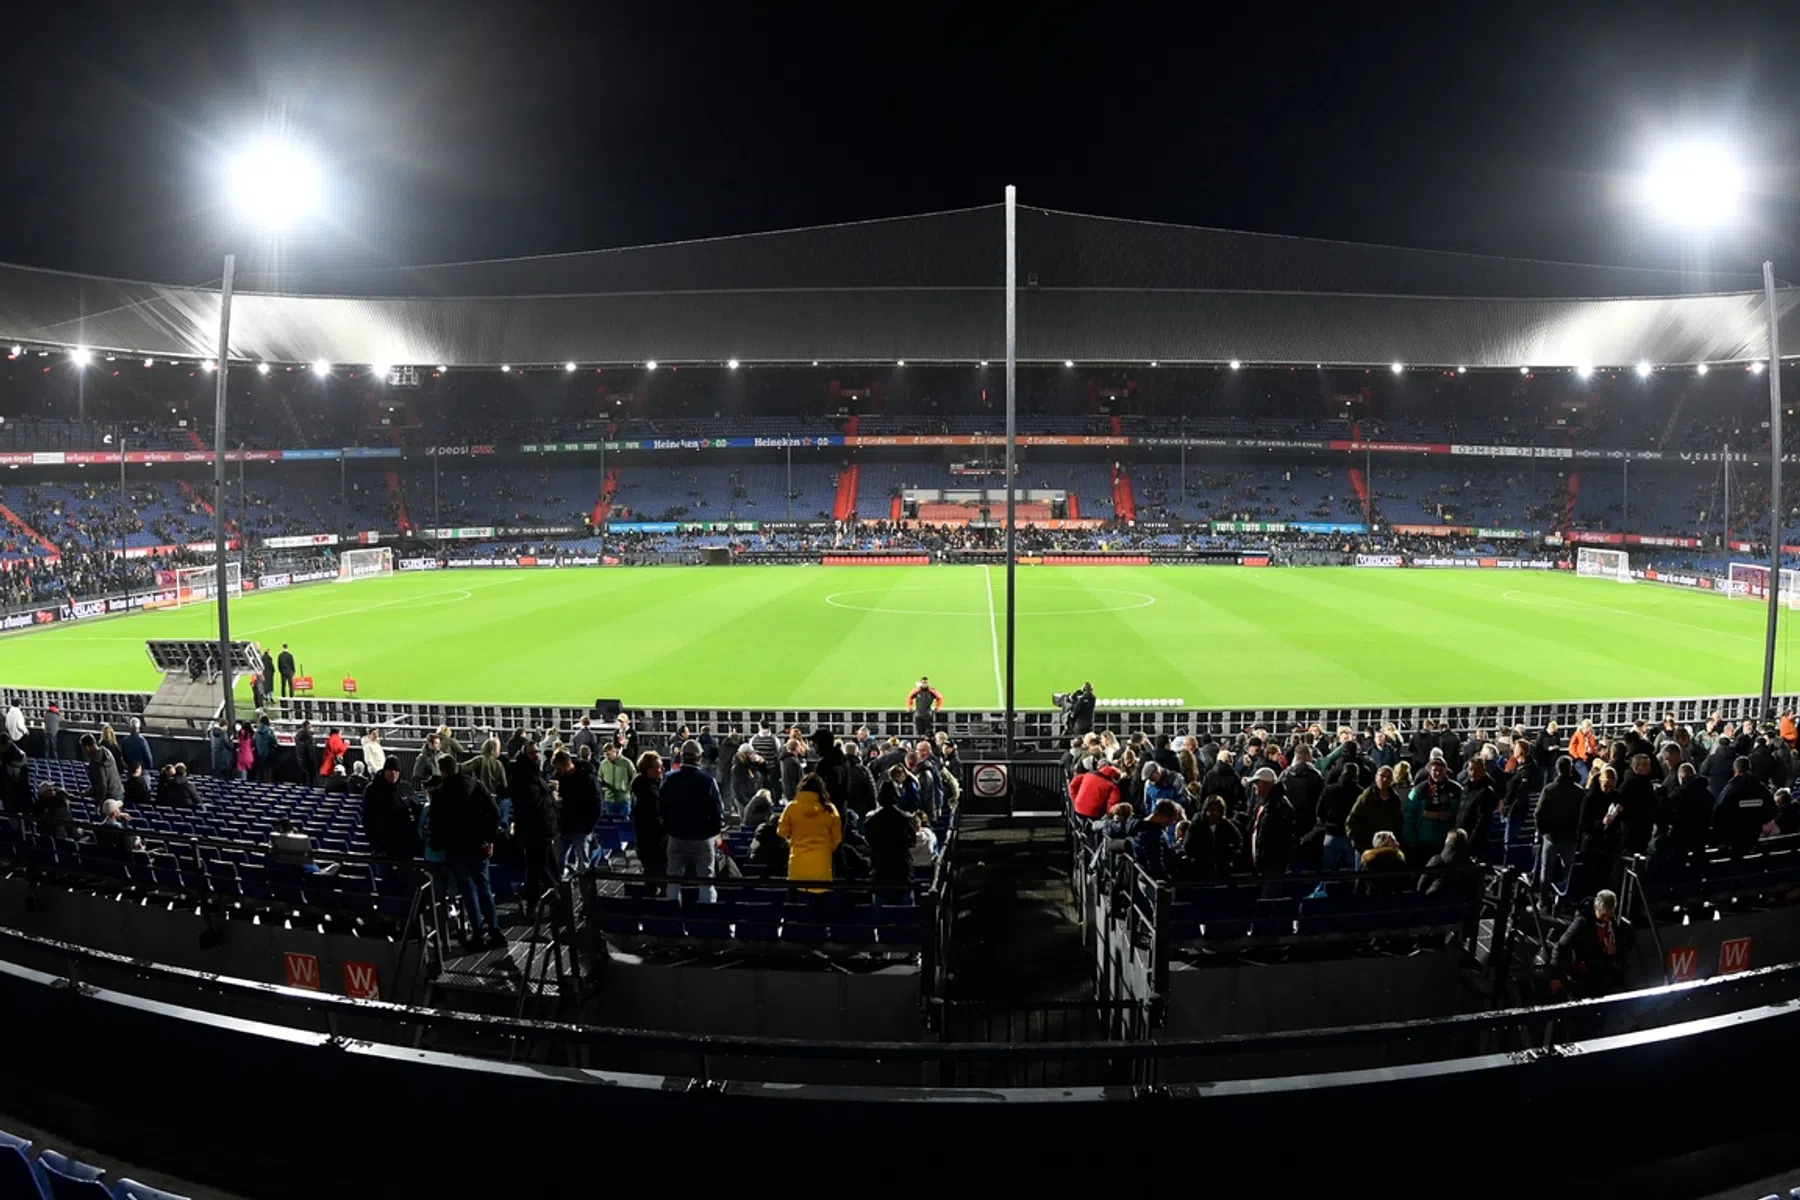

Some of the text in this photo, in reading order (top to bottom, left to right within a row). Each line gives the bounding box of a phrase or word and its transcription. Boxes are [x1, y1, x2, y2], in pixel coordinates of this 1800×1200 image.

[653, 439, 700, 449] Heineken
[754, 437, 801, 447] Heineken
[1695, 452, 1748, 462] CASTORE
[1216, 523, 1235, 531] TOTO
[1241, 523, 1260, 531] TOTO
[1266, 524, 1285, 532] TOTO
[1725, 941, 1749, 967] W
[1671, 950, 1694, 976] W
[288, 955, 313, 983] W
[347, 964, 372, 991] W
